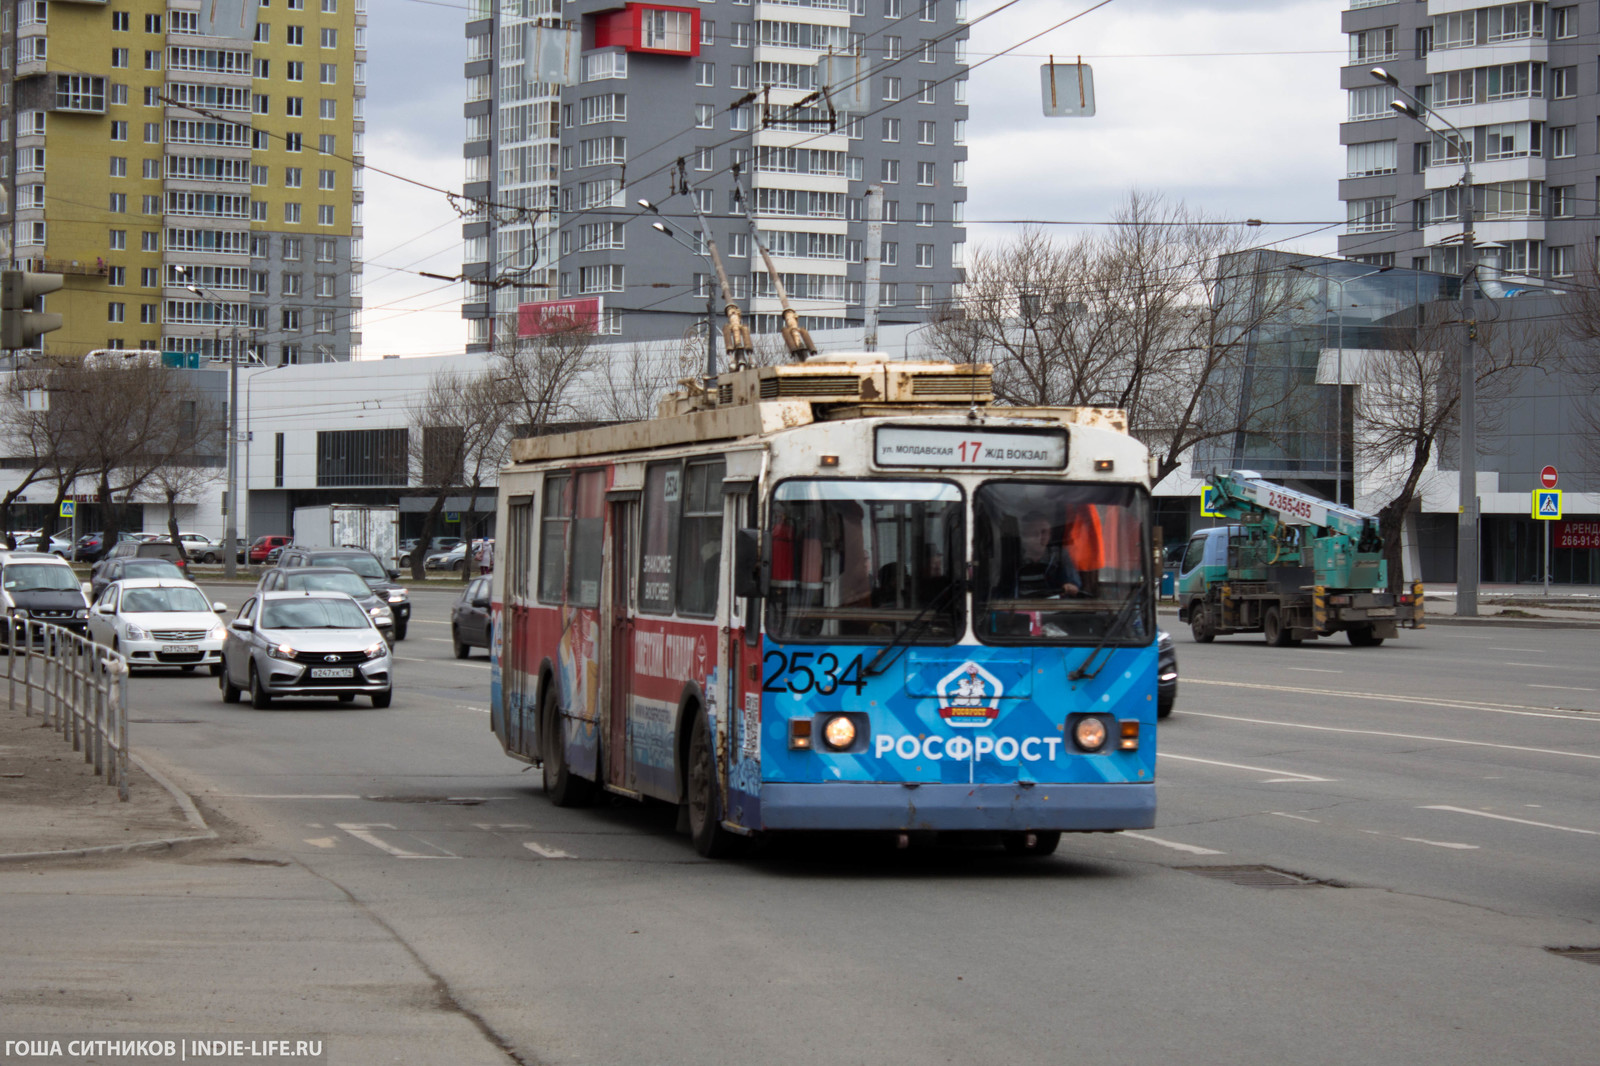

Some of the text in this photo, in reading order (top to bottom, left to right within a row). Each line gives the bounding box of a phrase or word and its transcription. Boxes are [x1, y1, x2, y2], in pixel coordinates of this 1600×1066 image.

[540, 304, 576, 322] ROCKY
[895, 445, 953, 456] МОЛДАВСКАЯ
[957, 441, 982, 463] 17
[985, 448, 1004, 460] Ж/Д
[1006, 449, 1048, 461] ВОКЗАЛ
[665, 476, 677, 496] 2534
[1269, 492, 1311, 518] 2-355-455
[1564, 523, 1600, 535] АРЕНД
[763, 650, 867, 696] 2534
[875, 733, 1062, 762] РОСФРОСТ
